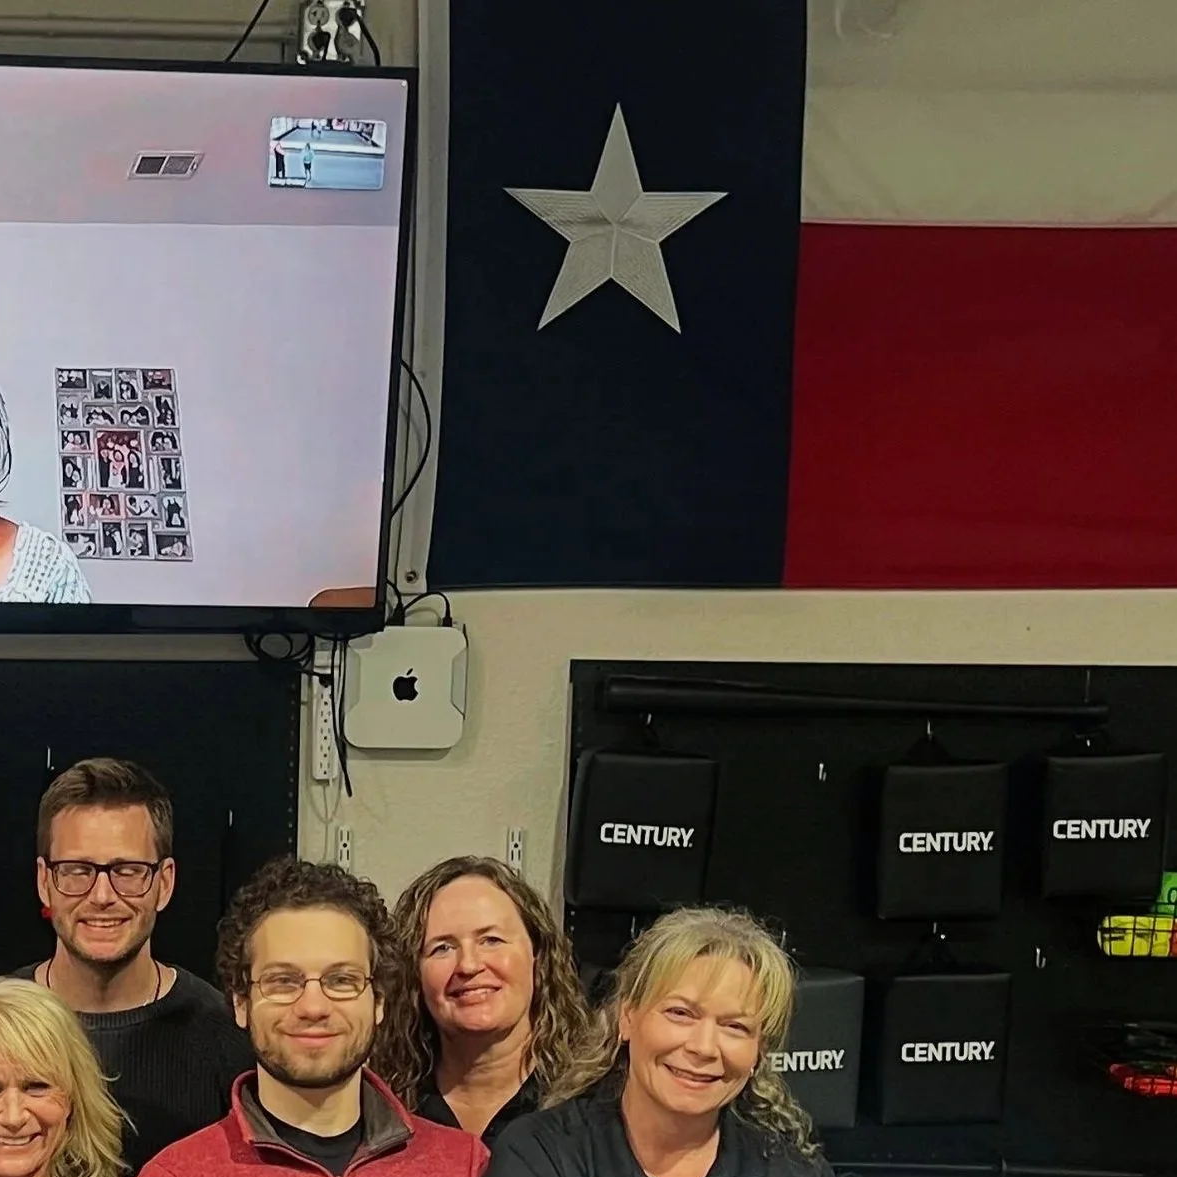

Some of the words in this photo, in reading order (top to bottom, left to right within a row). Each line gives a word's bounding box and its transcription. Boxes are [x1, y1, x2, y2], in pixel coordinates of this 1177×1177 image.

[600, 822, 695, 848] CENTURY
[1052, 817, 1152, 841] CENTURY
[898, 830, 995, 854] CENTURY
[766, 1049, 845, 1073] ENTURY
[900, 1040, 995, 1064] CENTURY
